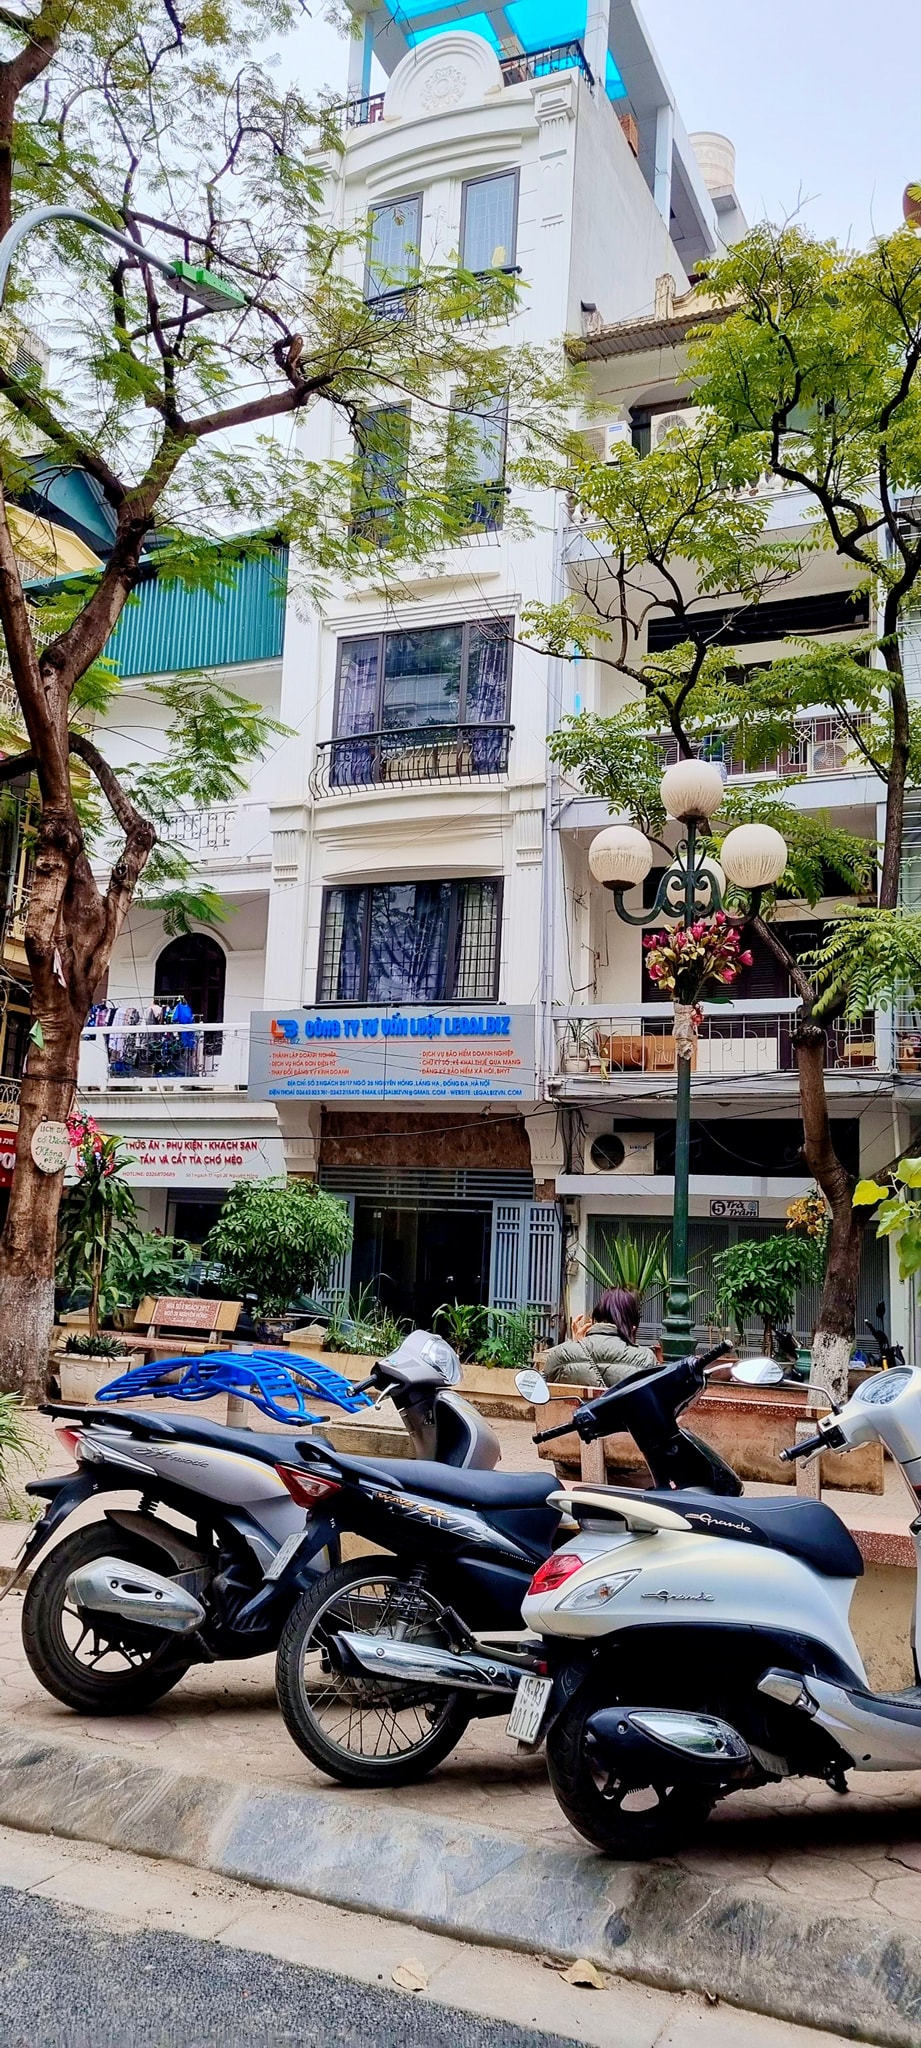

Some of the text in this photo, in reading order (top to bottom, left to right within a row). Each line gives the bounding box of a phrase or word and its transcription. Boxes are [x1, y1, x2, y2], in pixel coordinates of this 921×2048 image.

[305, 1012, 511, 1039] CÔNG TY TƯ VẤN LUẬT LEGALBIZ
[494, 1049, 513, 1057] NGHIỆP
[167, 1141, 182, 1152] PHỤ
[185, 1140, 203, 1152] KIỆN
[209, 1139, 238, 1150] KHÁCH
[240, 1141, 258, 1152] SẠN
[172, 1152, 187, 1165] CẮT
[204, 1153, 222, 1165] CHÓ
[225, 1154, 243, 1165] MÈO
[685, 1513, 752, 1533] Grande
[641, 1590, 716, 1604] Grande
